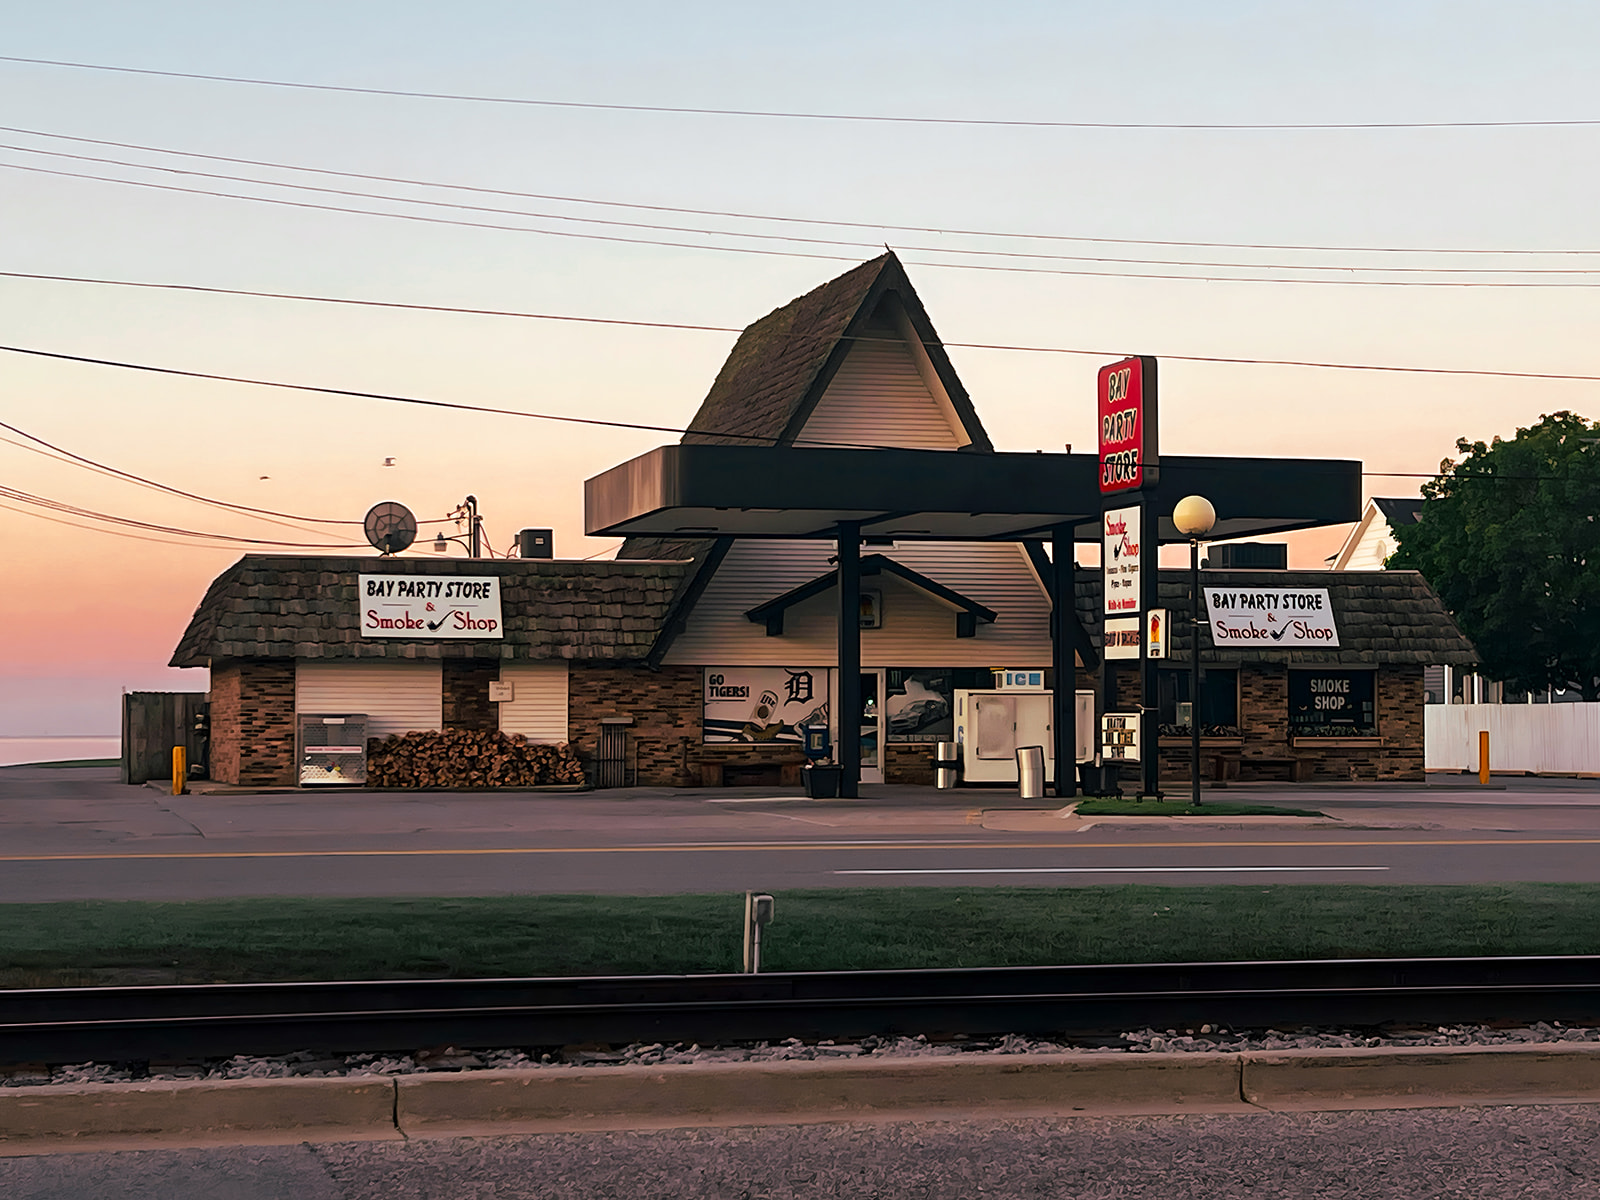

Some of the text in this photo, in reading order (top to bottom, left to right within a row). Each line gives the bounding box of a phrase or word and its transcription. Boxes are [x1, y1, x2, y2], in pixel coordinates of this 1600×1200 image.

[1108, 368, 1131, 403] BAY
[1102, 408, 1138, 446] PARTY
[1102, 448, 1138, 486] STORE
[1106, 513, 1127, 536] Smoke
[366, 580, 492, 599] BAY PARTY STORE
[425, 601, 436, 612] &
[1212, 593, 1323, 611] BAY PARTY STORE
[365, 609, 498, 633] Smoke Shop
[1267, 612, 1277, 623] &
[1216, 620, 1334, 642] Smoke Shop
[708, 674, 725, 686] GO
[1310, 679, 1350, 693] SMOKE
[708, 685, 750, 698] TIGERS!
[1314, 696, 1346, 710] SHOP
